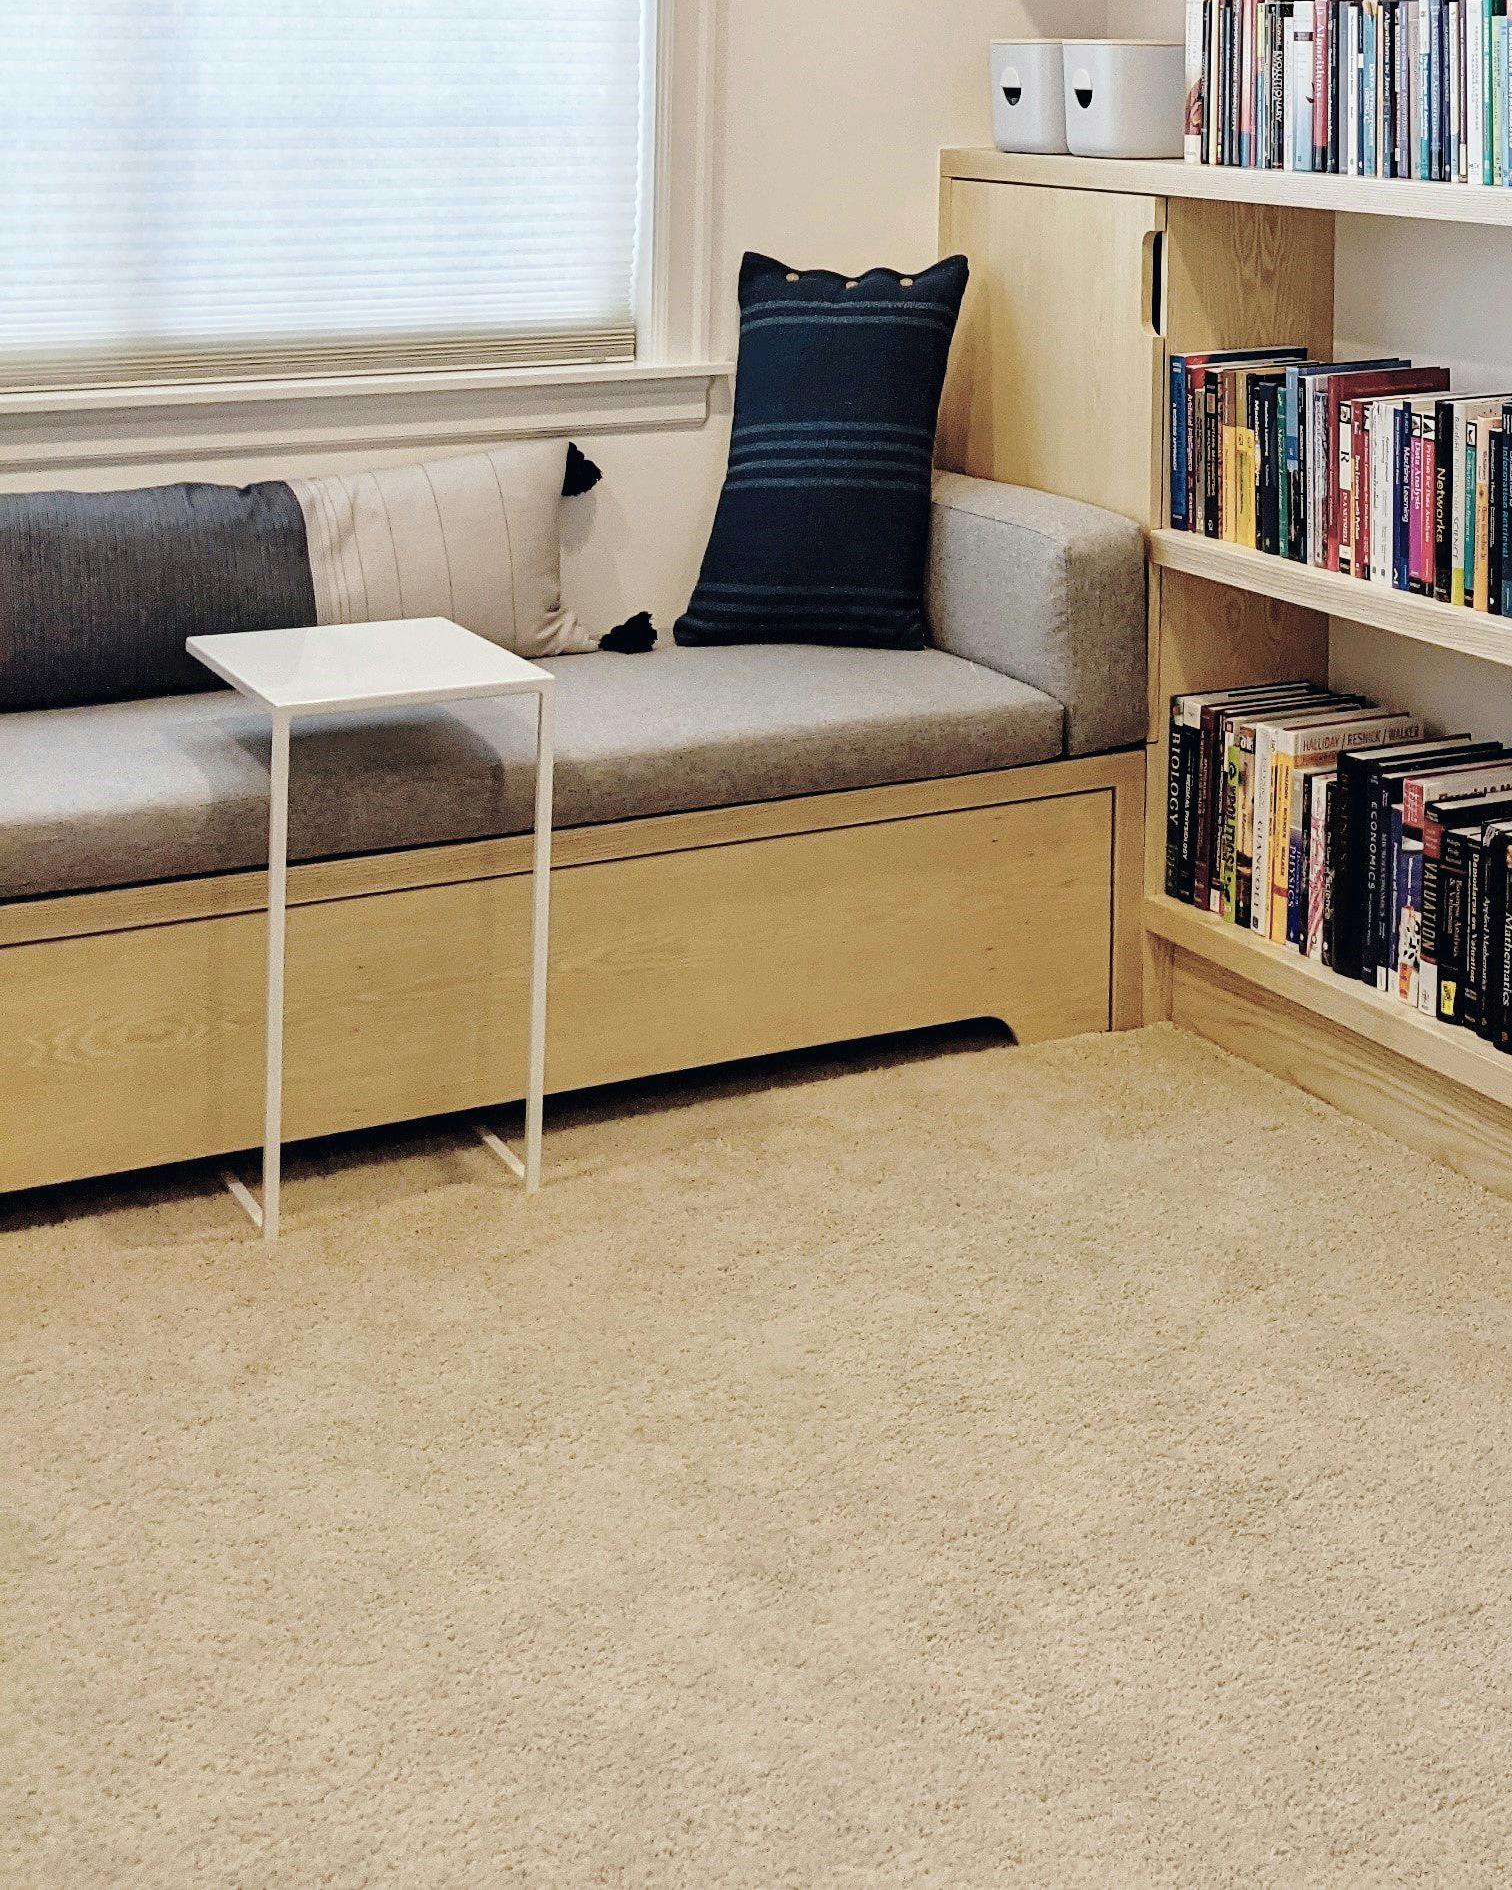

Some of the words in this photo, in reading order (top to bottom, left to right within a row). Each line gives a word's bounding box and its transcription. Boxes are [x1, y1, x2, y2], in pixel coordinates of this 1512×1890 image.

[1275, 51, 1283, 123] EVOLUTIONARY
[1402, 447, 1411, 484] Machine
[1402, 486, 1411, 523] Learning
[1435, 467, 1446, 543] Networks
[1169, 732, 1181, 826] BIOLOGY
[1302, 736, 1340, 752] HALLIDAY
[1254, 821, 1264, 907] GIANCOLI
[1287, 846, 1297, 908] PHYSICS
[1368, 801, 1378, 889] ECONOMICS
[1422, 862, 1438, 950] VALUATION
